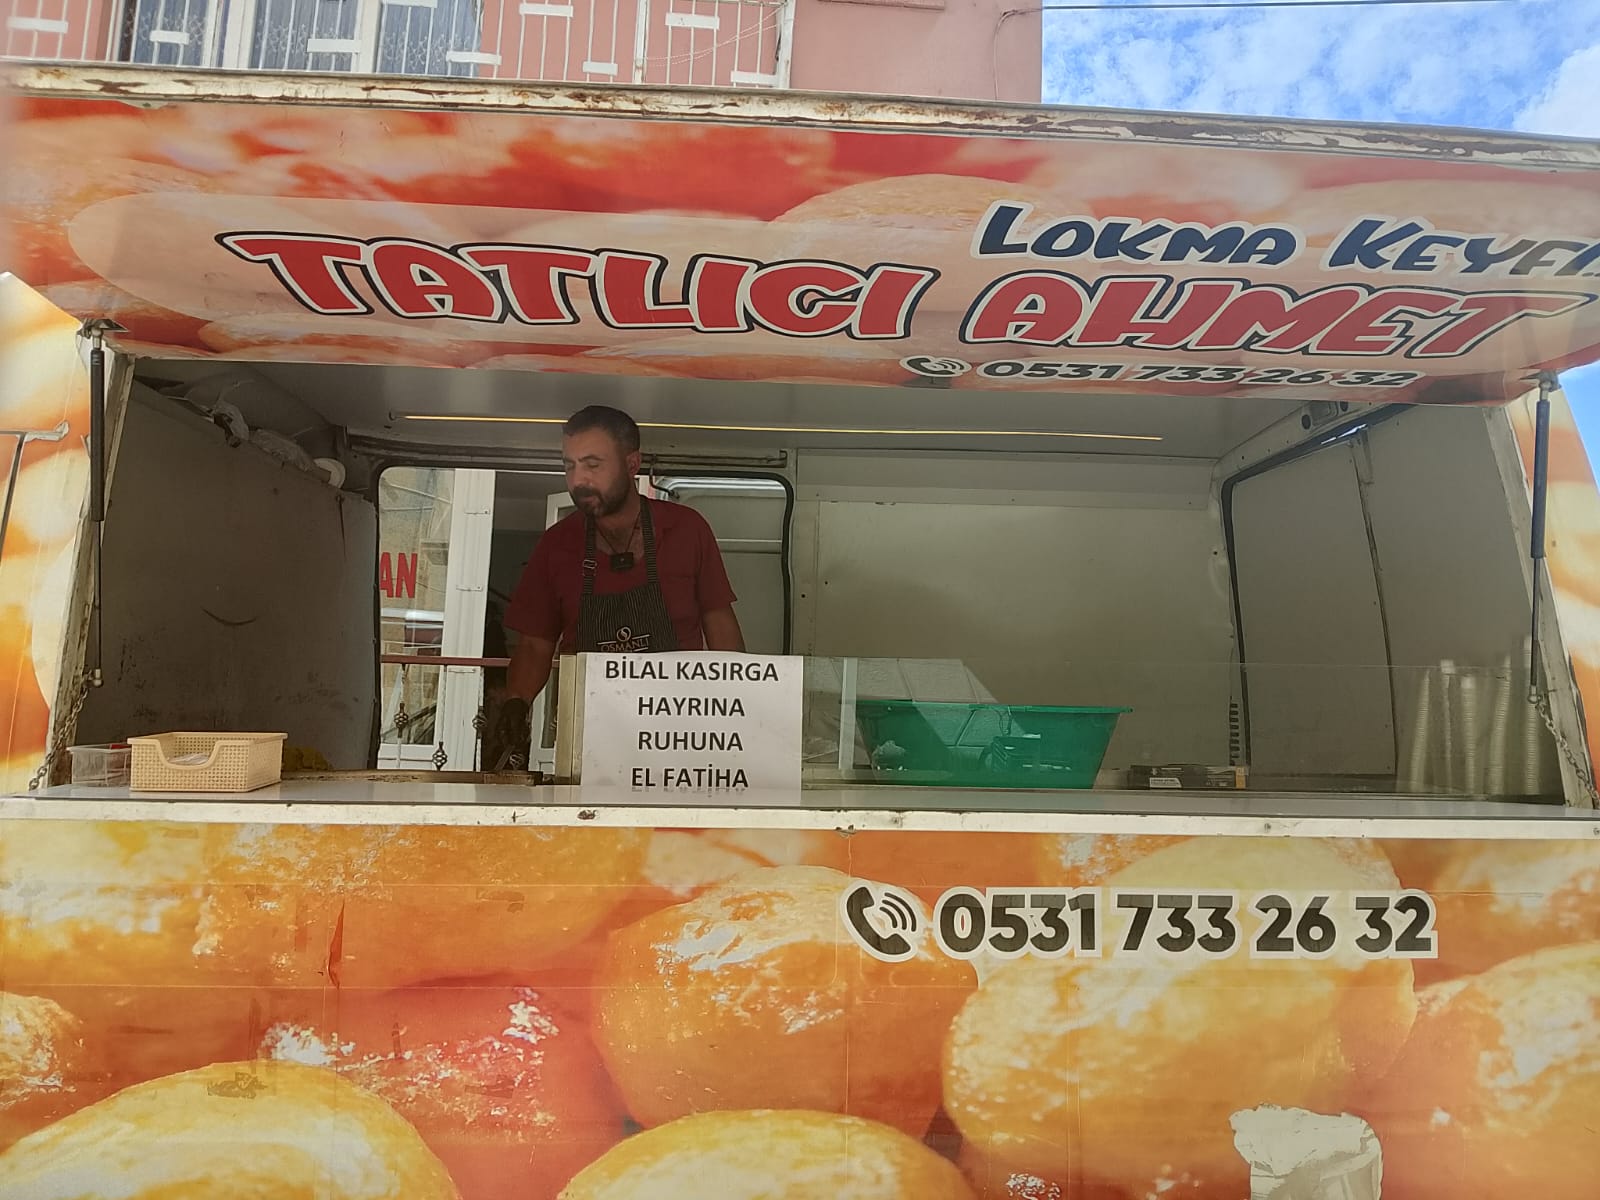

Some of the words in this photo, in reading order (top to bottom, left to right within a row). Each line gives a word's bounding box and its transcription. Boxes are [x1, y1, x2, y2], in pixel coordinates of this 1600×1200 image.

[979, 205, 1297, 266] LOKMA
[215, 232, 942, 340] TATLICI
[959, 269, 1598, 360] AHMET
[983, 361, 1123, 379] 0531
[1134, 365, 1246, 382] 733
[1248, 368, 1333, 384] 26
[1337, 371, 1422, 386] 32
[605, 655, 669, 680] BİLAL
[676, 662, 779, 682] KASIRGA
[638, 696, 746, 717] HAYRINA
[638, 731, 744, 751] RUHUNA
[631, 767, 656, 787] EL
[663, 763, 749, 788] FATİHA
[938, 894, 1097, 953] 0531
[1116, 894, 1236, 953] 733
[1255, 894, 1336, 953] 26
[1354, 894, 1432, 953] 32
